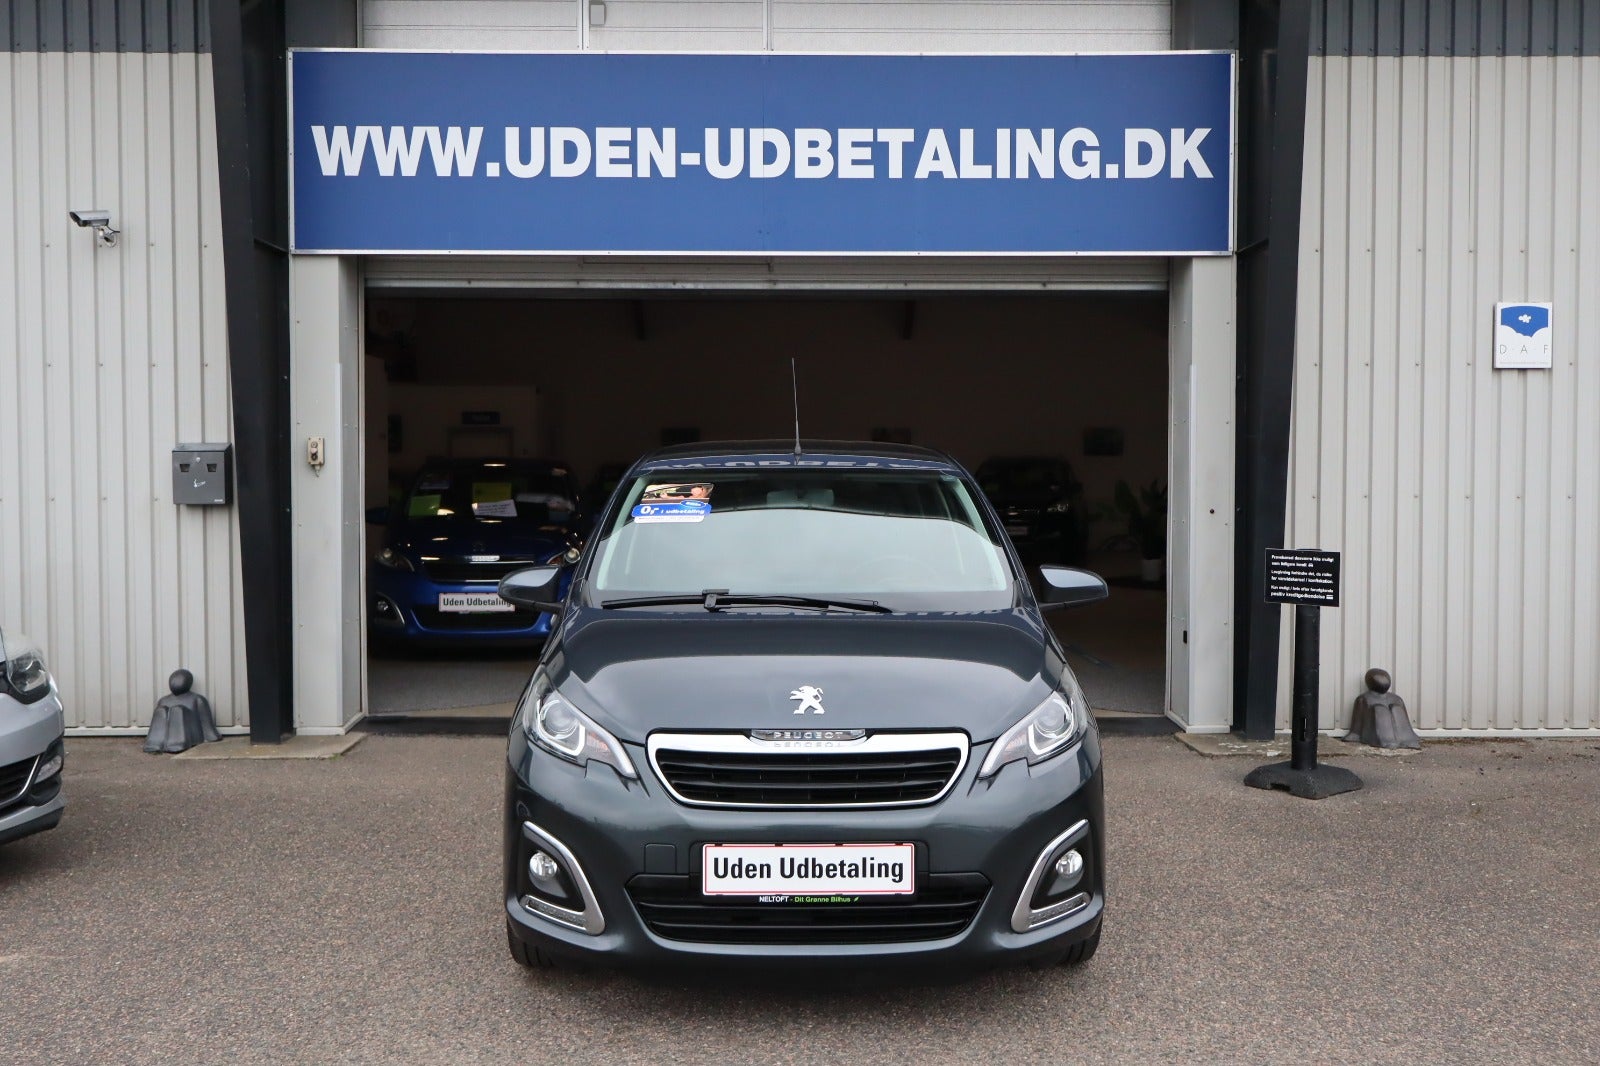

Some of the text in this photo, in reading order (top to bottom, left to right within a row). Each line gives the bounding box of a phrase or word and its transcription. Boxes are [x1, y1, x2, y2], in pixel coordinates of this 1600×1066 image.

[311, 125, 1214, 180] WWW.UDEN-UDBETALING.DK
[443, 597, 464, 606] Uden
[773, 731, 843, 739] PEUGEOT
[713, 857, 904, 883] Uden Udbetaling
